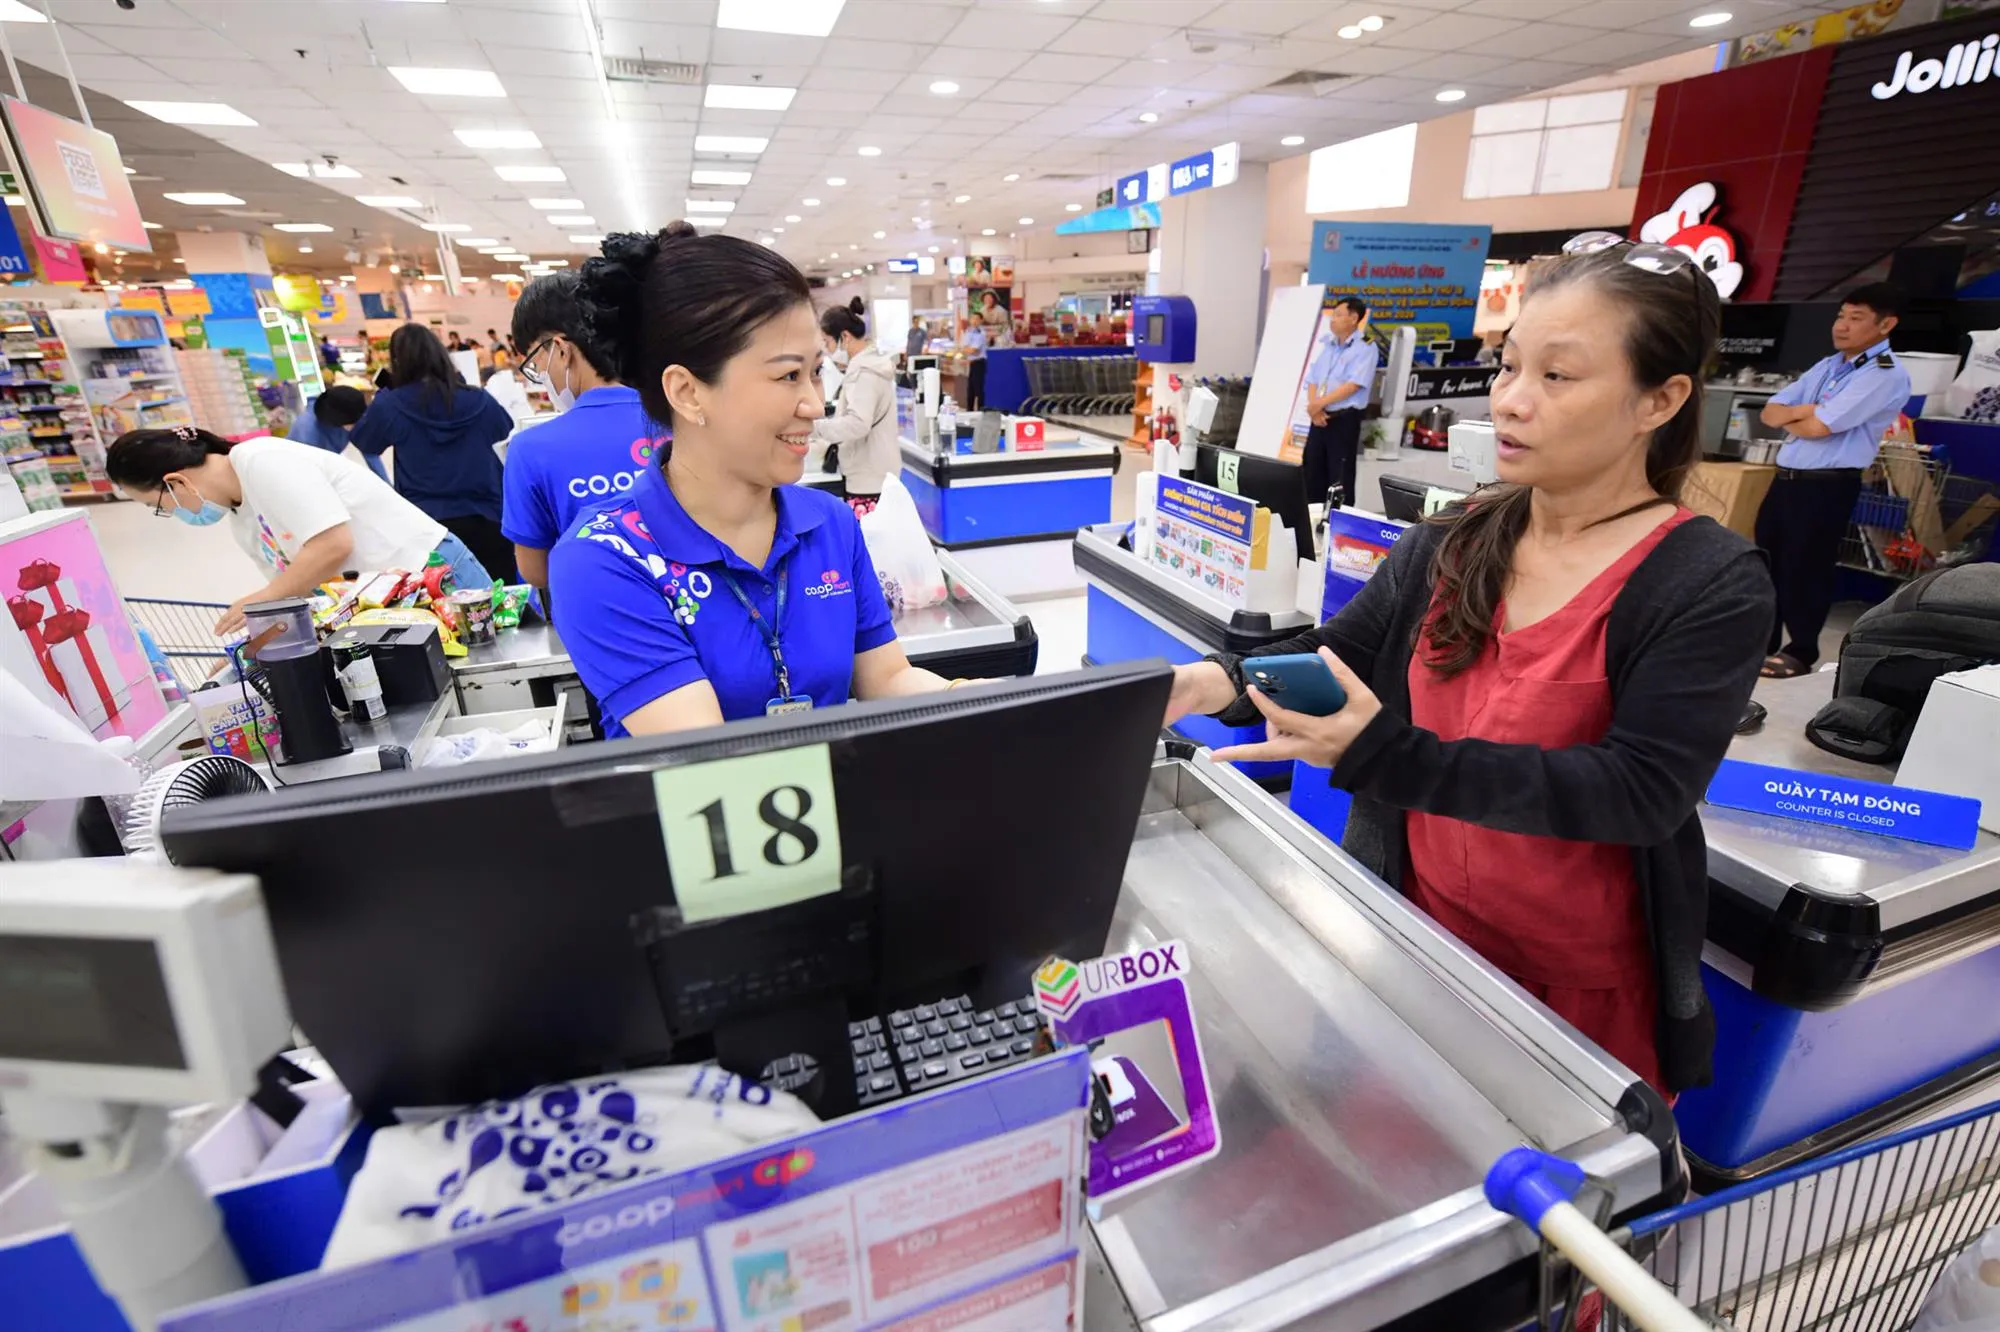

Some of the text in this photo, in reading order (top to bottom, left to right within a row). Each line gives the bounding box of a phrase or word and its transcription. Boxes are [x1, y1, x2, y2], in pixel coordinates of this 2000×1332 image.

[1871, 33, 2000, 100] Jolli
[1221, 460, 1236, 481] 15
[1764, 780, 1921, 816] QUẦY TẠM ĐÓNG
[1776, 801, 1895, 827] COUNTER IS CLOSED
[686, 784, 820, 882] 18
[1084, 945, 1180, 994] URBOX
